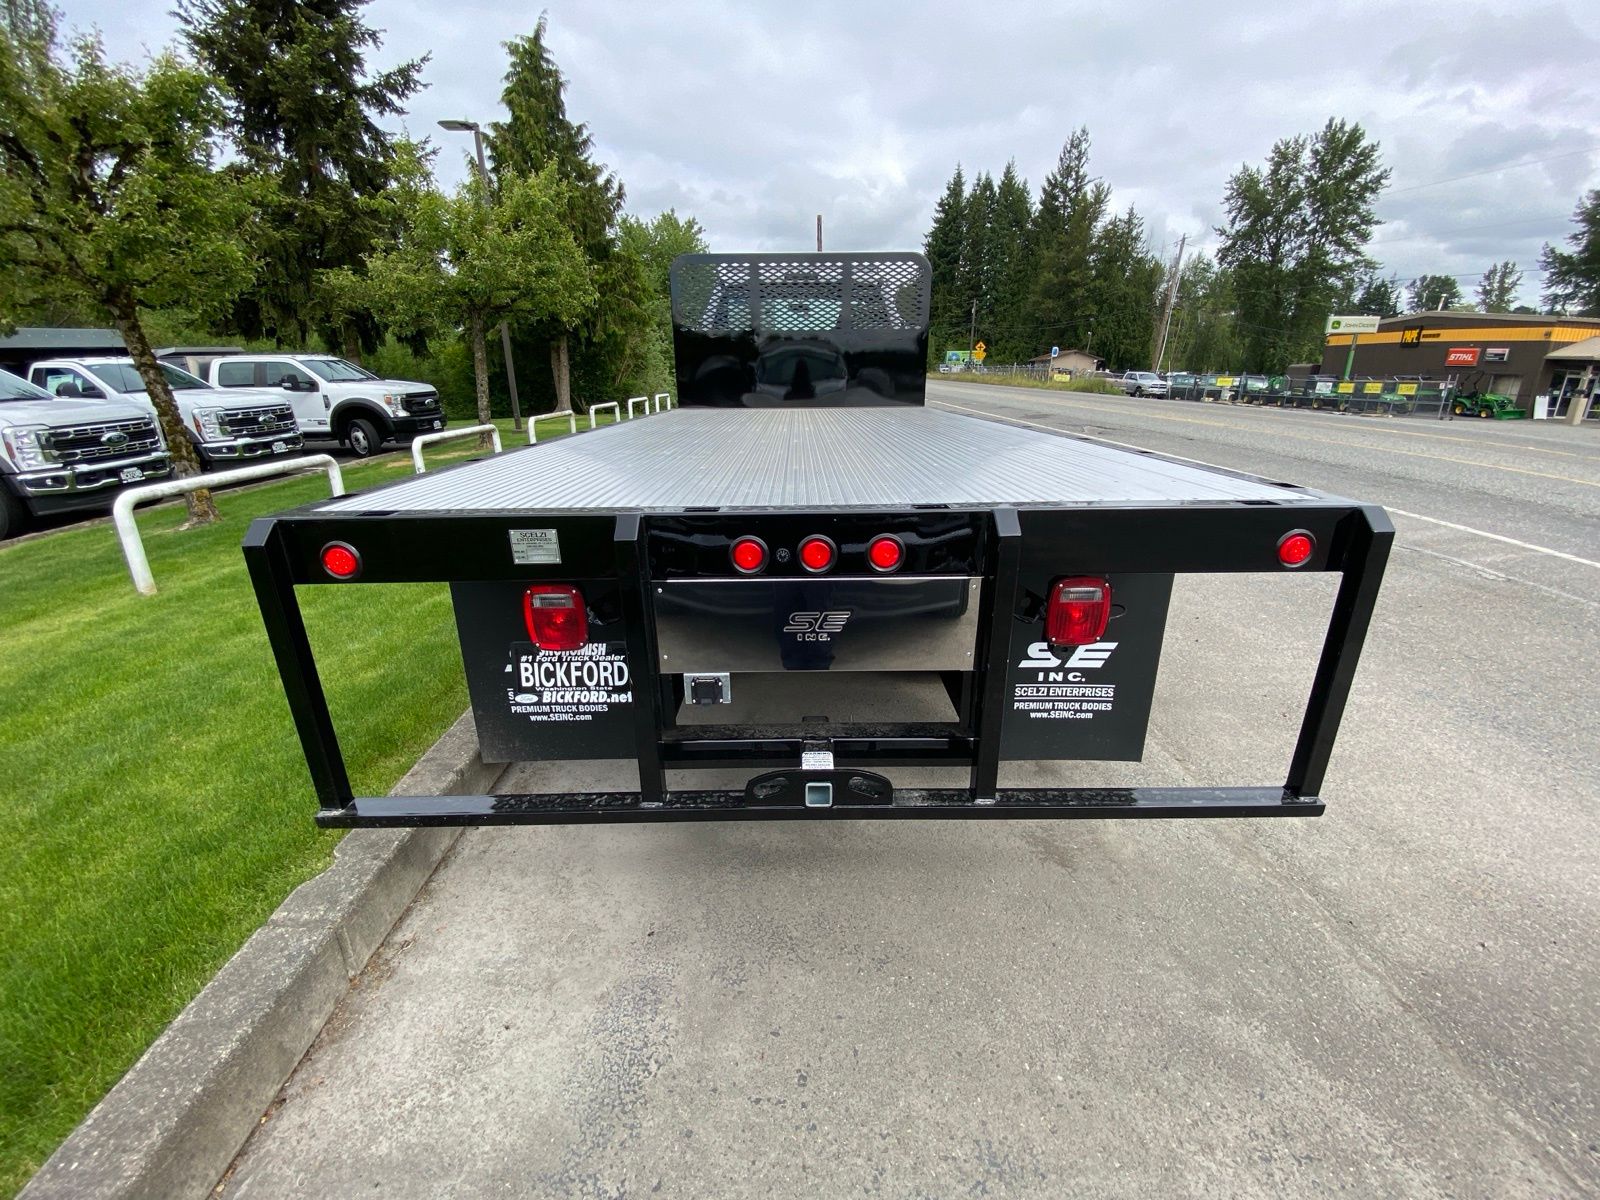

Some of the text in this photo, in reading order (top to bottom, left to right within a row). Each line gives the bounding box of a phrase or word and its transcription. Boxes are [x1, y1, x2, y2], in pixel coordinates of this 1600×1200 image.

[1448, 353, 1474, 361] STIHL
[783, 611, 851, 632] SE
[797, 633, 831, 641] INC.
[1018, 642, 1119, 668] SE
[520, 661, 629, 687] BICKFORD
[1037, 672, 1086, 682] INC.
[542, 691, 632, 703] BICKFORD.net
[1014, 687, 1114, 697] SCELZI ENTERPRISES
[511, 705, 550, 714] PREMIUM
[579, 704, 609, 712] BODIES
[1013, 702, 1113, 710] PREMIUM TRUCK BODIES
[529, 713, 592, 721] www.SEINC.com
[1030, 710, 1093, 719] www.SEINC.com
